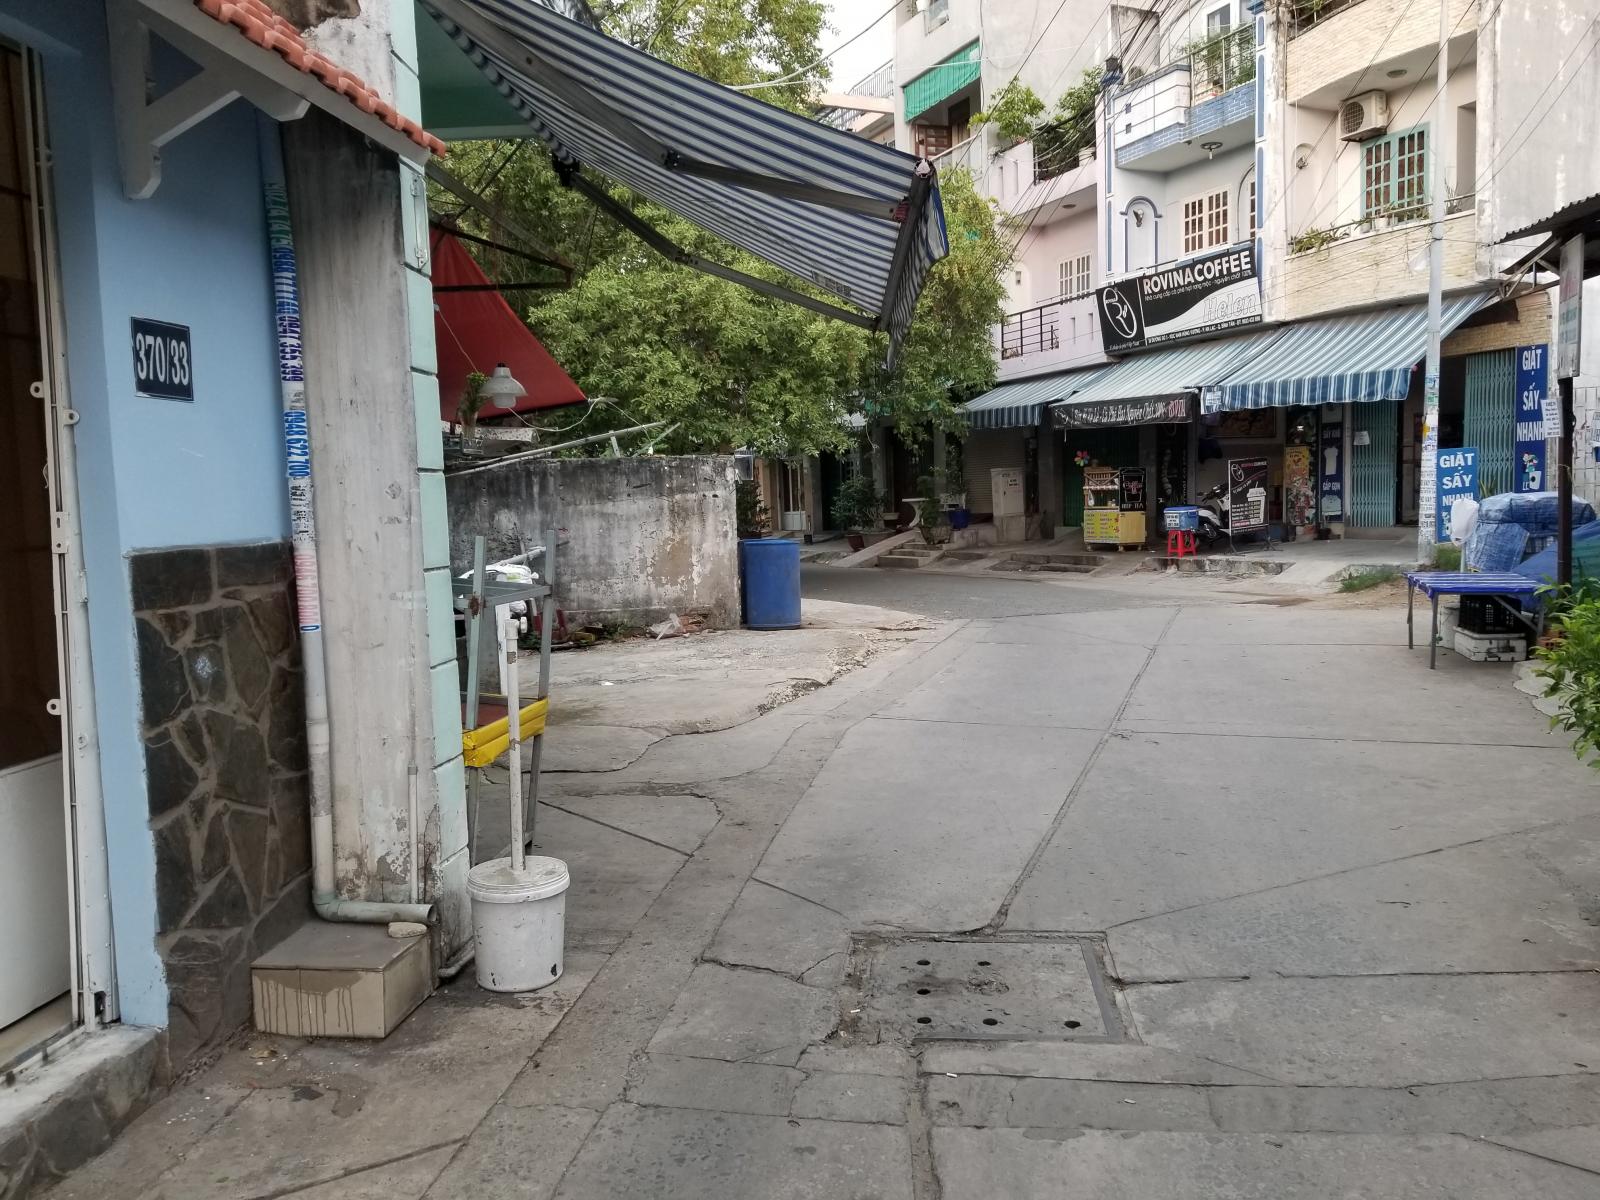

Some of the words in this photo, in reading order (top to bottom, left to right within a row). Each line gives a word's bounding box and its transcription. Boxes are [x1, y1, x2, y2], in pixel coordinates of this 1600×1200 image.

[1202, 293, 1256, 323] Helen
[136, 332, 189, 386] 370/33
[1522, 345, 1542, 374] GIẶT
[1522, 382, 1540, 410] SẤY
[284, 411, 307, 436] 0948
[1516, 421, 1545, 441] NHANH
[286, 438, 309, 457] 622
[288, 458, 310, 477] 700
[1440, 452, 1474, 469] GIẶT
[1442, 471, 1472, 489] SẤY
